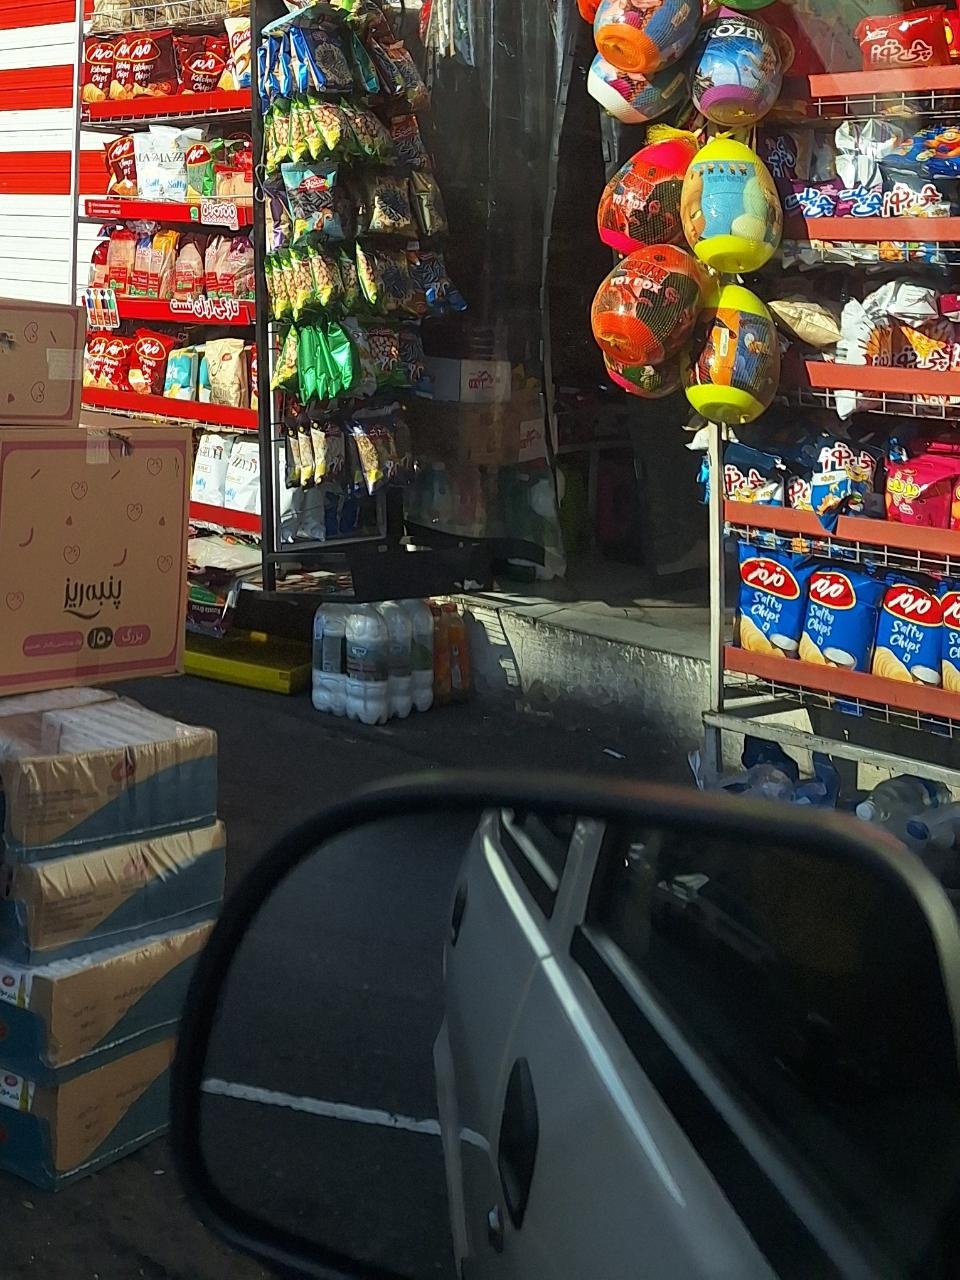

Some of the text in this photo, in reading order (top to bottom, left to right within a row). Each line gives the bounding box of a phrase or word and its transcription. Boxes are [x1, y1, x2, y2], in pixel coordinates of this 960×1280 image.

[752, 591, 783, 612] Salty
[750, 604, 781, 623] Chips
[808, 604, 835, 624] Salty
[121, 628, 143, 644] بزرگ
[807, 617, 833, 636] Chips
[891, 620, 925, 642] Salty
[889, 634, 921, 654] Chips
